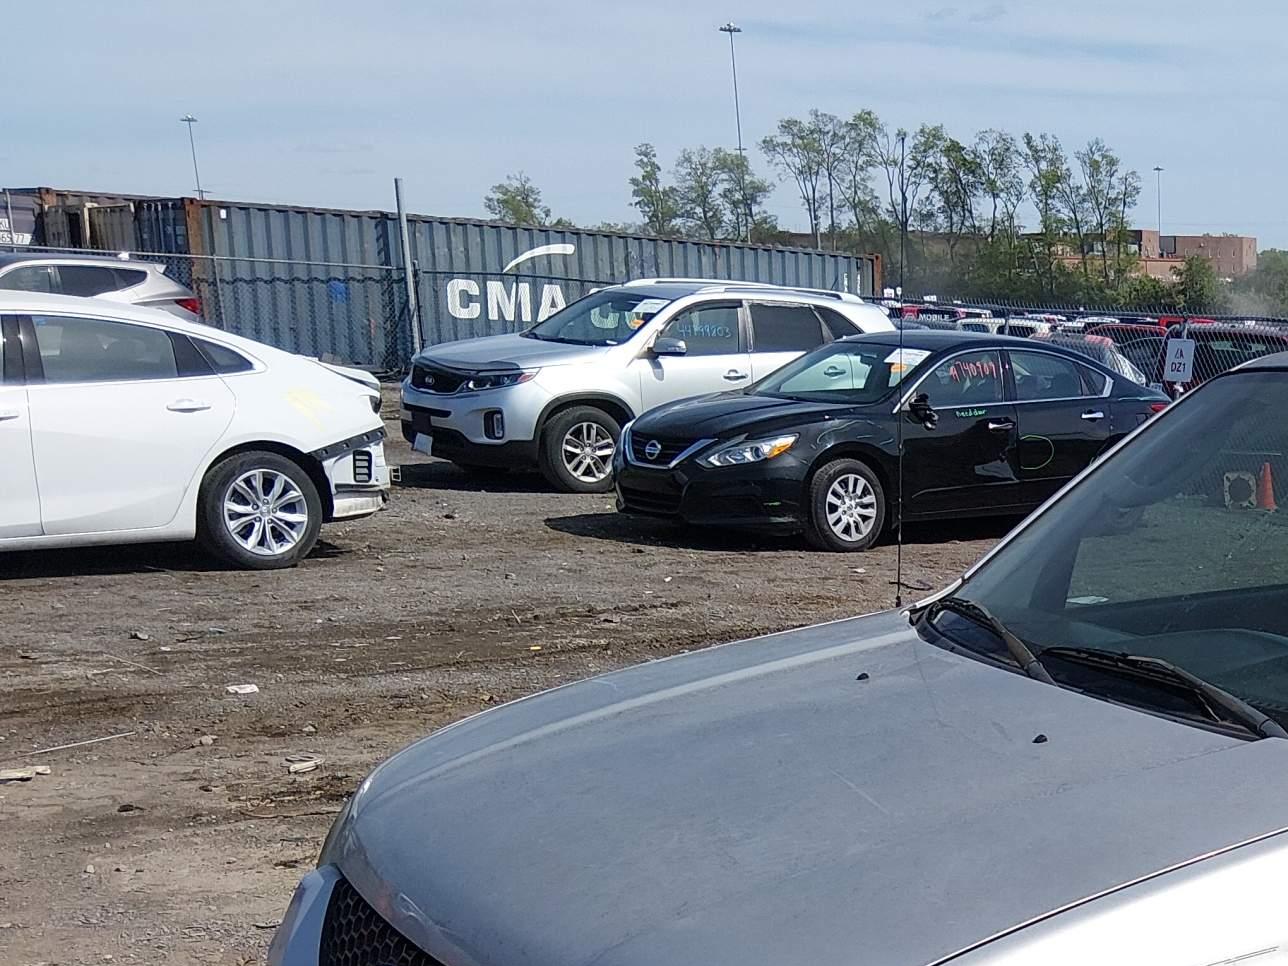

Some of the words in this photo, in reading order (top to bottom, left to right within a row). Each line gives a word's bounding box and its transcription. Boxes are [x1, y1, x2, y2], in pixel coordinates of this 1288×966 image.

[446, 278, 567, 322] CMA
[917, 312, 950, 322] MOBILE
[1170, 361, 1186, 373] DZ1
